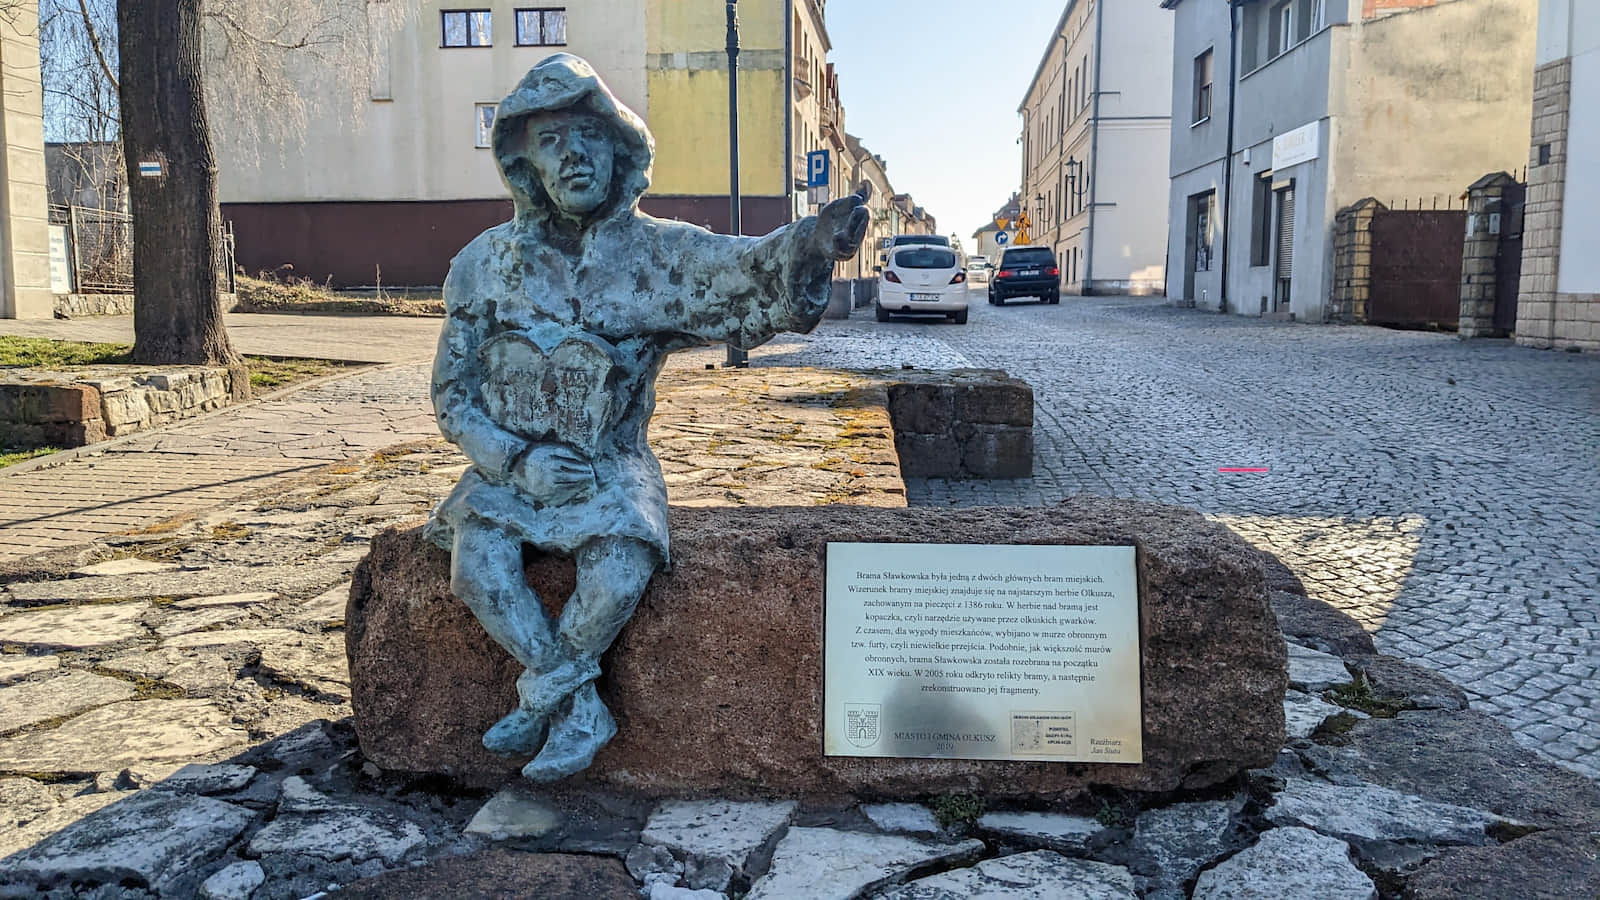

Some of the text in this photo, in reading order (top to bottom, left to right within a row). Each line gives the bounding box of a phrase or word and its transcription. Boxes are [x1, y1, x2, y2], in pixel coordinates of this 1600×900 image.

[812, 154, 825, 182] P
[856, 571, 881, 580] Brama
[883, 571, 929, 581] Sławkowska
[931, 572, 947, 582] była
[949, 572, 970, 583] jedną
[978, 573, 1003, 581] dwóch
[1005, 574, 1042, 583] głównych
[1044, 574, 1064, 583] bram
[1065, 575, 1104, 584] miejskich.
[848, 585, 887, 593] Wizerunek
[889, 585, 912, 595] bramy
[914, 585, 949, 596] miejskiej
[950, 586, 983, 597] znajduje
[984, 588, 997, 597] się
[1008, 588, 1053, 599] najstarszym
[1055, 588, 1080, 597] herbie
[1080, 589, 1115, 598] Olkusza,
[863, 600, 912, 609] zachowanym
[925, 600, 955, 611] pieczęci
[964, 601, 983, 609] 1386
[984, 602, 1004, 610] roku.
[1006, 602, 1015, 610] W
[1017, 602, 1041, 610] herbie
[1042, 602, 1057, 610] nad
[1058, 603, 1083, 613] bramą
[1084, 603, 1099, 613] jest
[865, 613, 1097, 627] kopaczka, czyli narzędzie używane przez olkuskich gwarków.
[855, 627, 862, 635] Z
[863, 628, 893, 636] czasem,
[895, 627, 907, 635] dla
[908, 628, 938, 639] wygody
[940, 628, 993, 638] mieszkańców,
[995, 629, 1031, 639] wybijano
[1067, 631, 1107, 641] obronnym
[851, 641, 1112, 655] tzw. furty, czyli niewielkie przejścia. Podobnie, jak większość murów
[865, 655, 907, 665] obronnych,
[909, 655, 933, 664] brama
[934, 655, 982, 666] Sławkowska
[983, 657, 1010, 666] została
[1012, 658, 1050, 667] rozebrana
[1063, 659, 1099, 669] początku
[868, 668, 885, 677] XIX
[887, 669, 912, 678] wieku.
[914, 669, 923, 677] W
[925, 669, 944, 678] 2005
[945, 670, 963, 678] roku
[965, 670, 995, 681] odkryto
[996, 671, 1022, 682] relikty
[1023, 671, 1050, 682] bramy,
[1058, 673, 1096, 684] następnie
[921, 683, 1041, 696] zrekonstruowano jej fragmenty.
